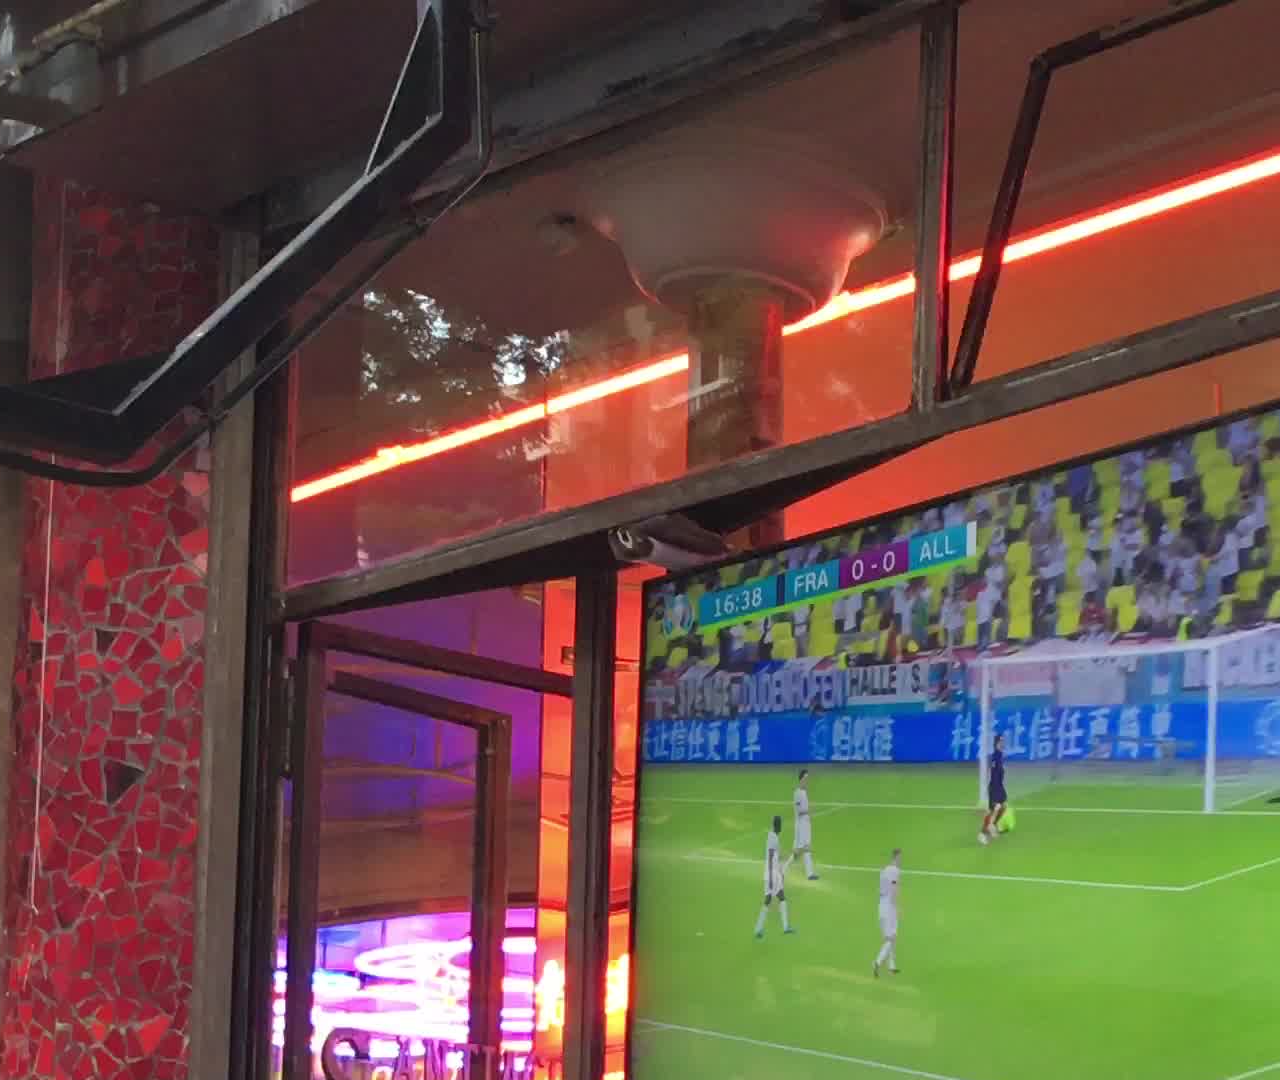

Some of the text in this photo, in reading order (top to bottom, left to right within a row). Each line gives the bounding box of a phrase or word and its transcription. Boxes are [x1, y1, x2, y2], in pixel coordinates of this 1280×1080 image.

[712, 587, 763, 618] 16:38
[793, 569, 829, 597] FRA
[919, 534, 956, 562] ALL
